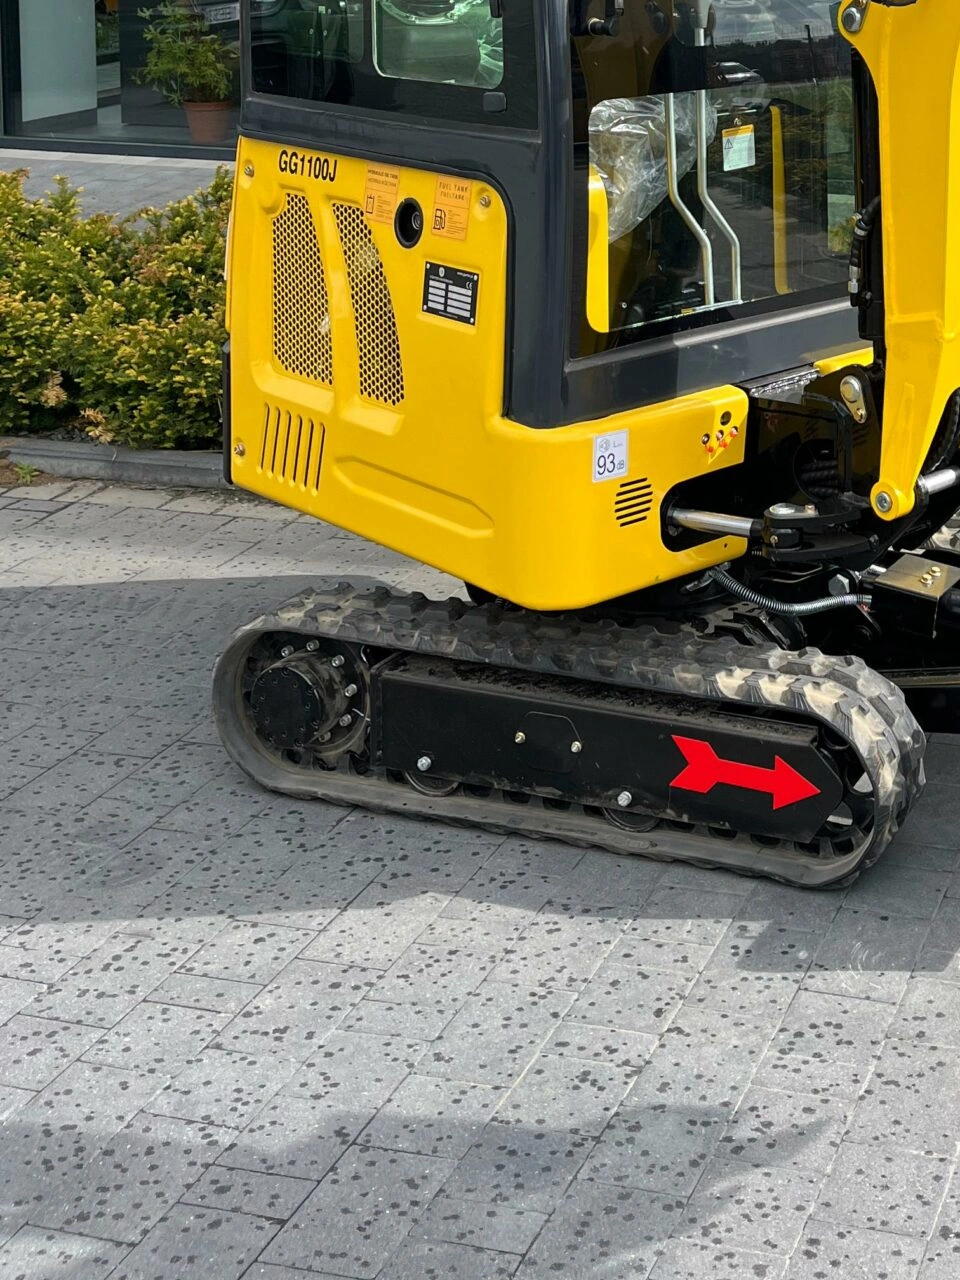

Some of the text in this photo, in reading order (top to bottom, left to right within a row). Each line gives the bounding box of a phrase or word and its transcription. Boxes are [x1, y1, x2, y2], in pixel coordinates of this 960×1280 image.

[278, 149, 338, 182] GG1100J
[439, 181, 468, 192] FUEL TANK
[597, 452, 625, 475] 93 dB
